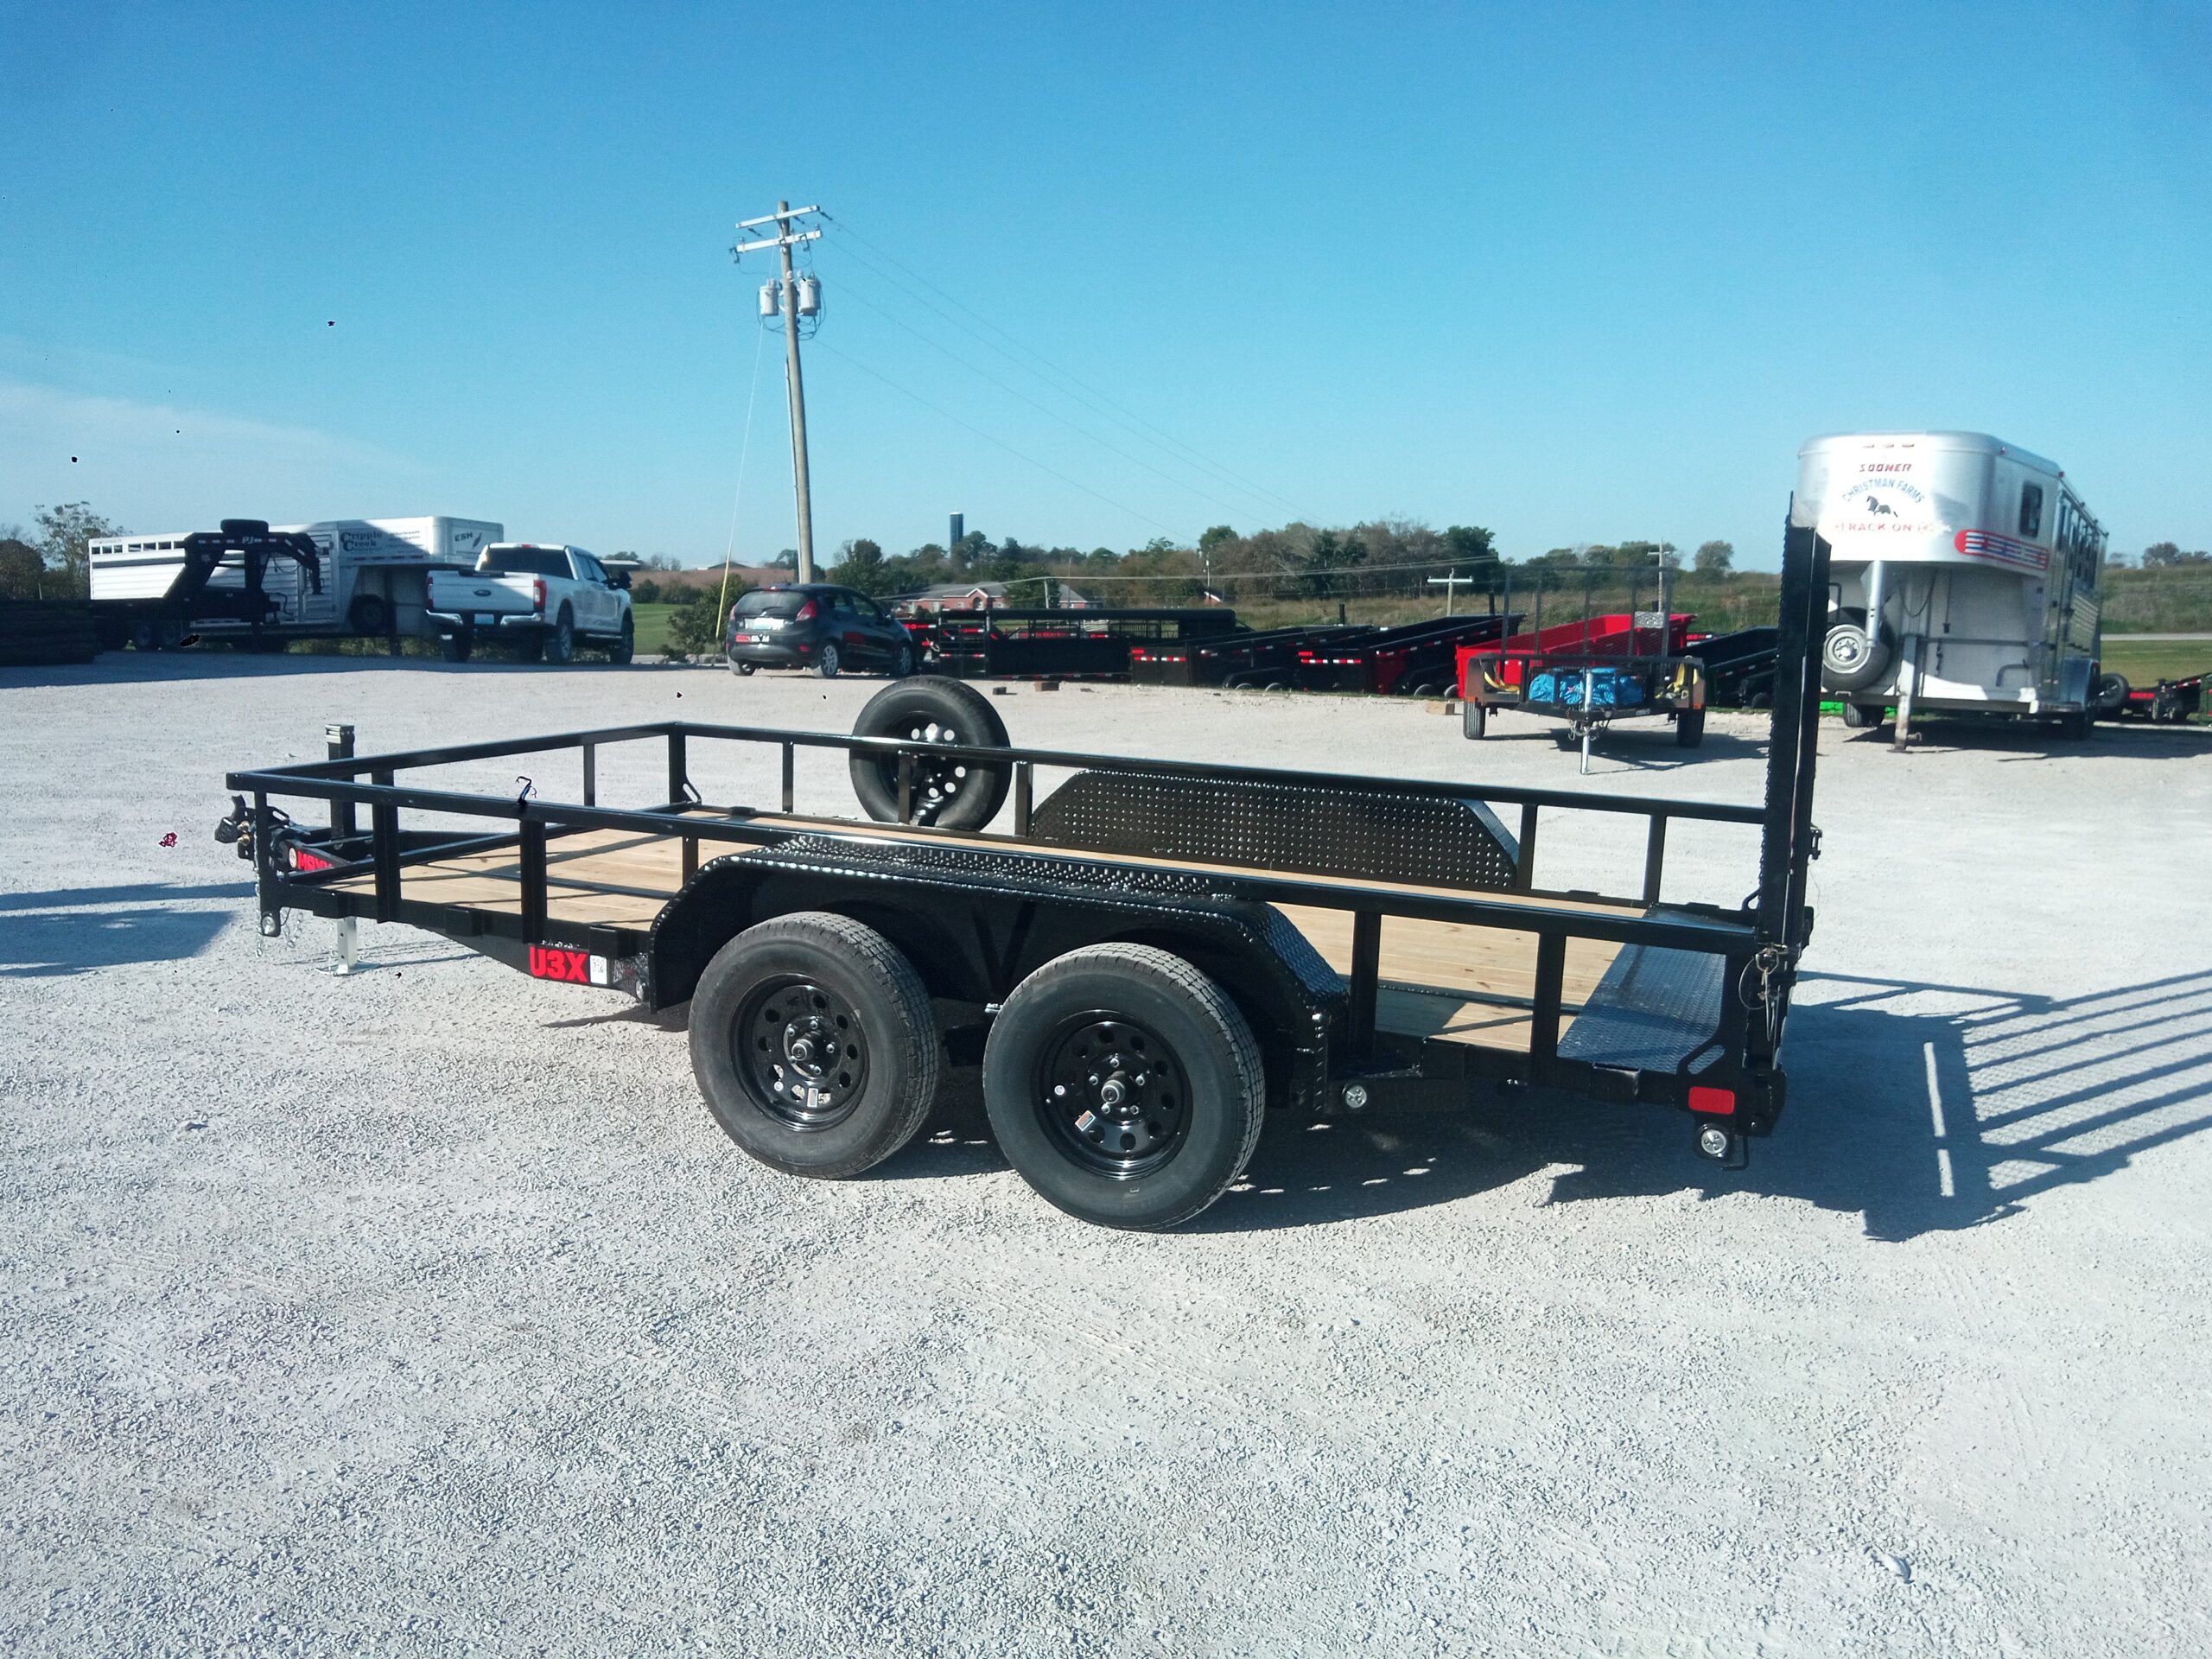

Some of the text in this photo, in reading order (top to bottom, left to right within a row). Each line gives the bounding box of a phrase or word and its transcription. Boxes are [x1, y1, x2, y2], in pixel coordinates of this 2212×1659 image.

[1859, 463, 1911, 472] SOONER
[1842, 478, 1925, 503] CHRISTMAN FARMS
[343, 539, 377, 551] Creek
[529, 945, 588, 982] U3X
